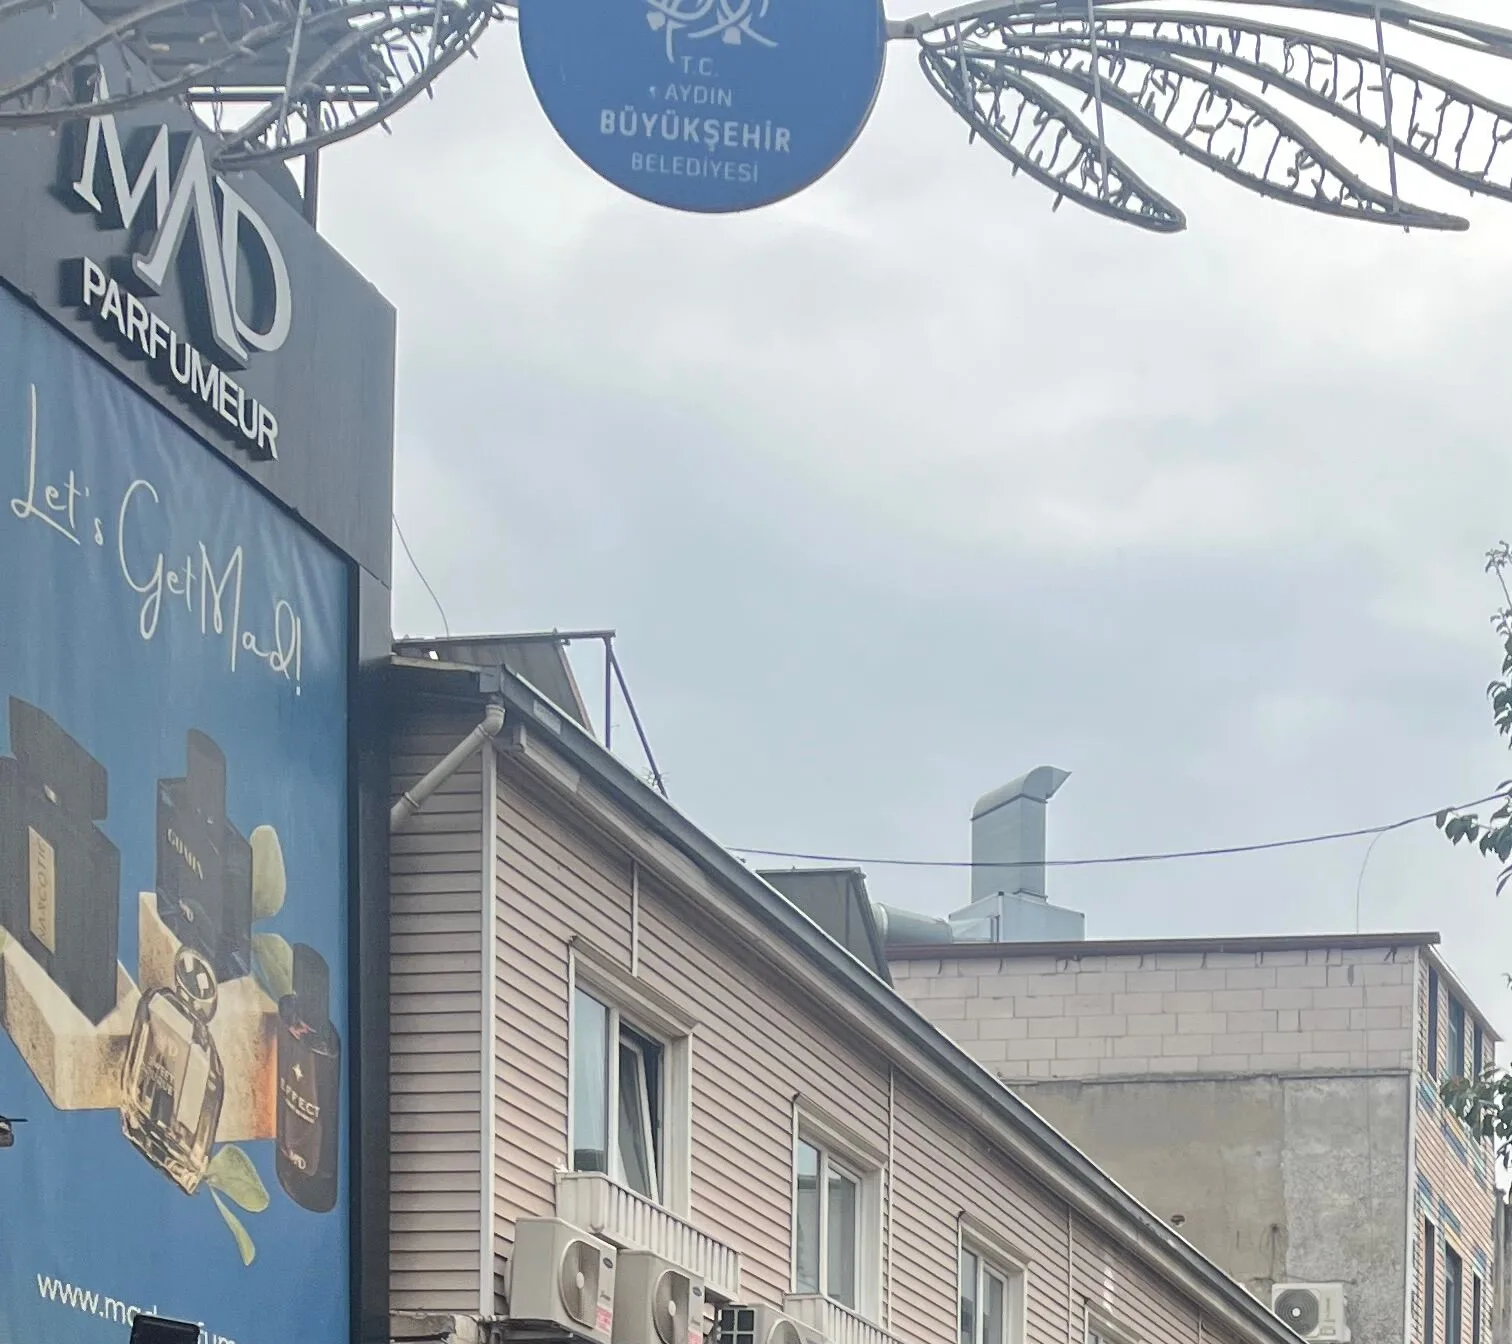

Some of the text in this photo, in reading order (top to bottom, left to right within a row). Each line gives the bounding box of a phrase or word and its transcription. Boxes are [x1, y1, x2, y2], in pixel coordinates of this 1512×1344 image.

[680, 55, 719, 77] T.C.
[664, 82, 733, 108] AYDIN
[600, 105, 792, 154] BÜYÜKŞEHİR
[631, 151, 760, 184] BELEDİYESİ
[72, 64, 292, 361] MAD
[82, 256, 280, 462] PARFUMEUR
[10, 382, 105, 548] Let's
